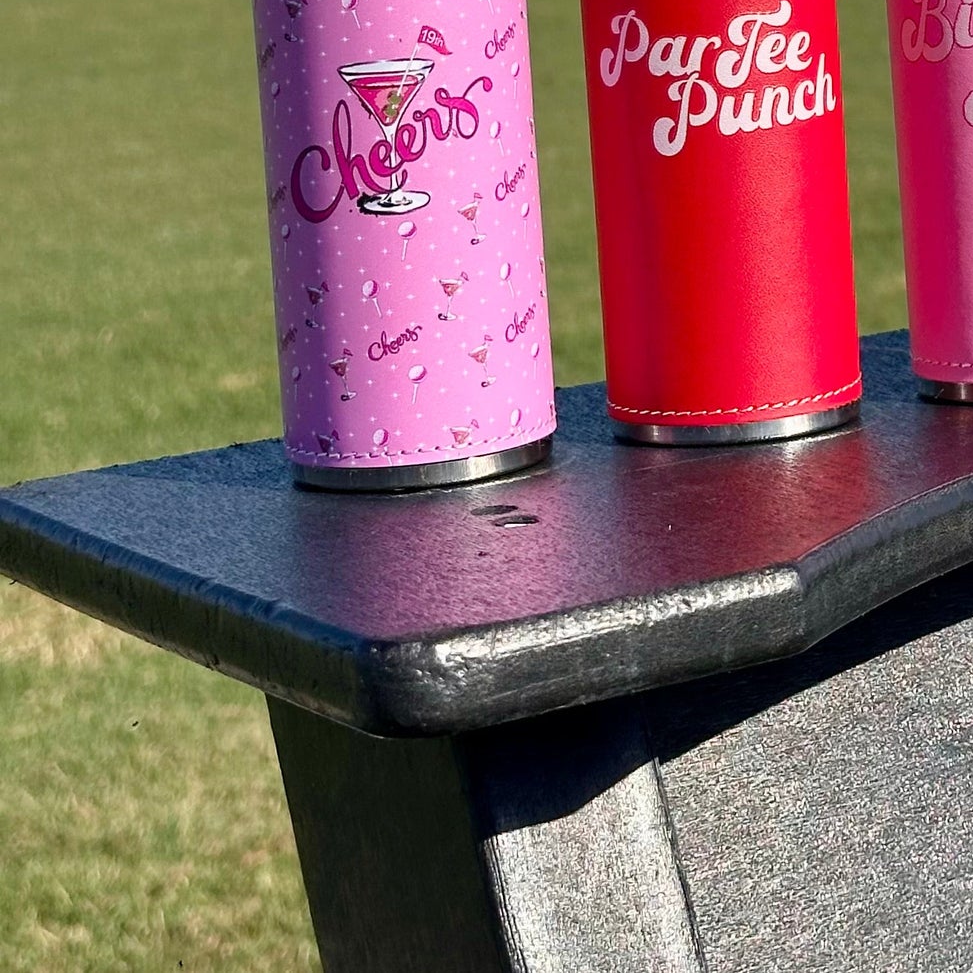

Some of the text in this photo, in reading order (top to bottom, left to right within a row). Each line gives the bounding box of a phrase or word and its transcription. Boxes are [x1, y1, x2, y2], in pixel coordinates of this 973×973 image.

[600, 0, 812, 88] ParTee
[290, 76, 493, 224] Cheers
[653, 53, 836, 156] Punch
[367, 325, 422, 362] Cheers
